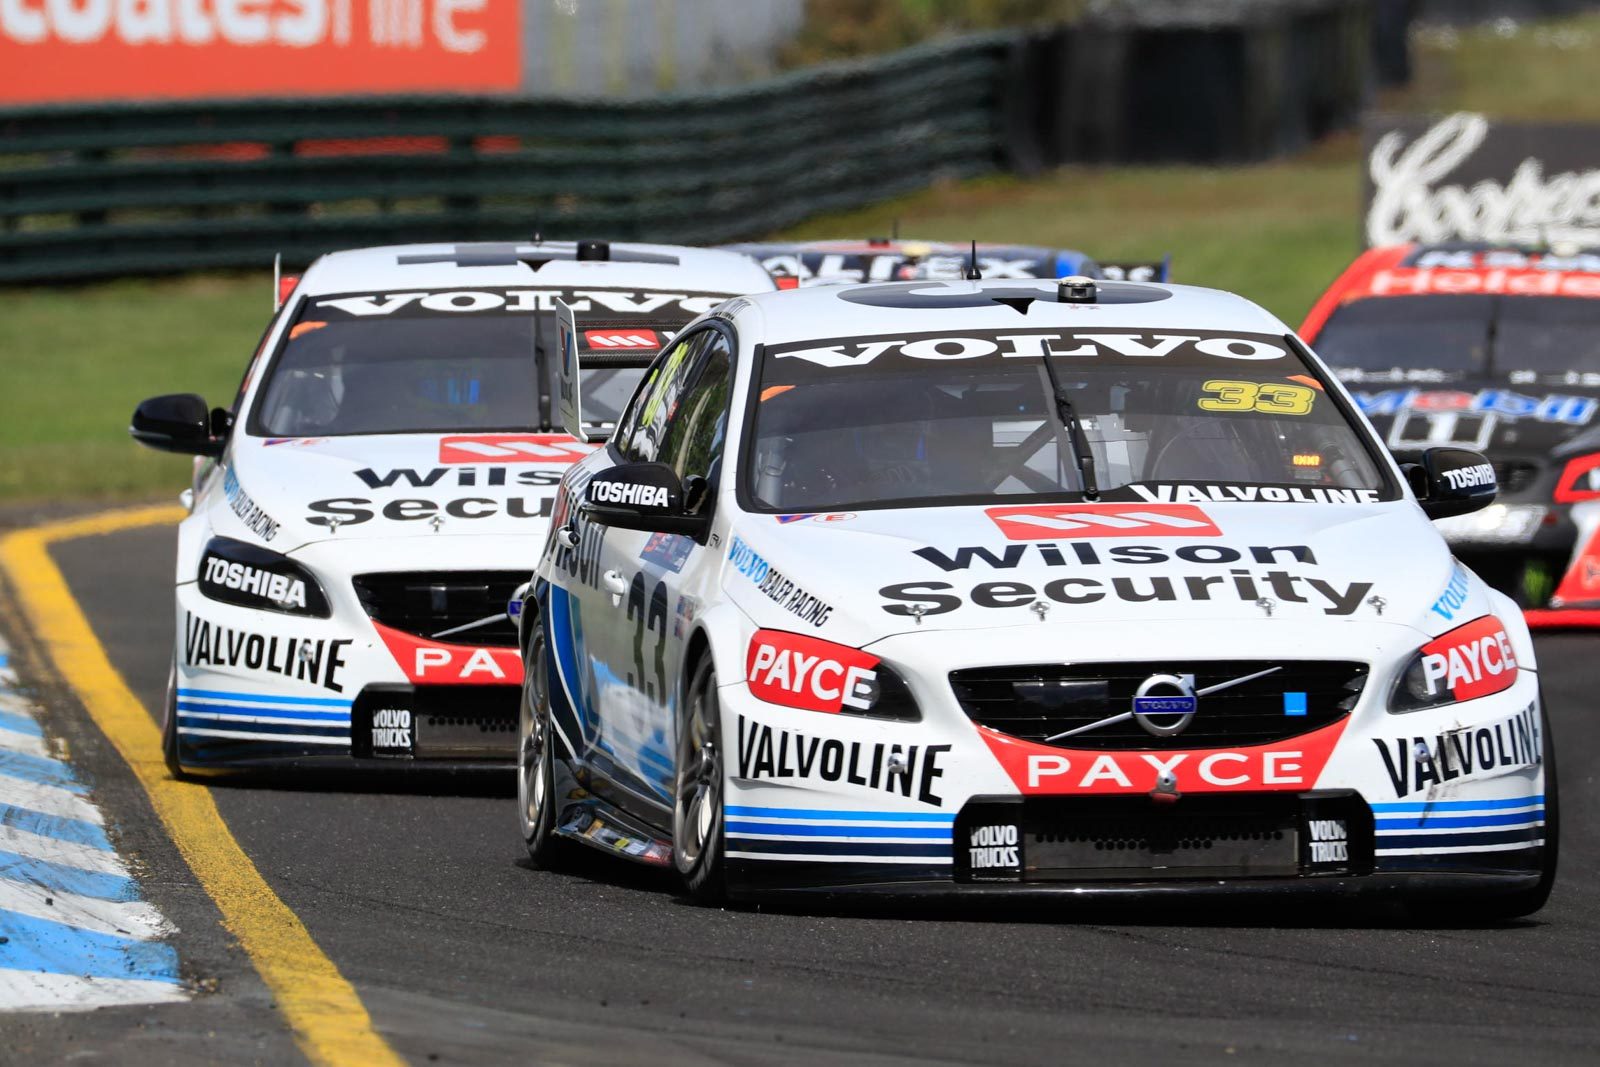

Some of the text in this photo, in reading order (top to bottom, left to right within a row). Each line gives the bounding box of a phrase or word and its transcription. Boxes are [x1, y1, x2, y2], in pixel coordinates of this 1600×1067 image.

[774, 333, 1287, 367] VOLVO
[1197, 380, 1317, 416] 33
[353, 467, 565, 490] Wils
[591, 480, 669, 508] TOSHIBA
[1128, 484, 1381, 503] VALVOLINE
[1441, 463, 1498, 490] TOSHIB
[305, 497, 555, 527] Secu
[911, 541, 1319, 572] Wilson
[203, 557, 308, 608] TOSHIBA
[728, 535, 769, 584] VOLVO
[758, 567, 794, 606] DEALER
[784, 588, 834, 628] RACING
[877, 569, 1376, 617] Security
[1431, 567, 1468, 620] VOL
[185, 610, 354, 694] VALVOLINE
[1421, 630, 1517, 697] PAYCE
[749, 644, 878, 711] PAYCE
[373, 709, 411, 728] VOLVO
[371, 728, 412, 748] TRUCKS
[1371, 700, 1542, 799] VALVOLINE
[738, 713, 953, 808] VALVOLINE
[1027, 750, 1304, 788] PAYCE
[970, 824, 1018, 847] VOLVO
[969, 846, 1020, 868] TRUCKS
